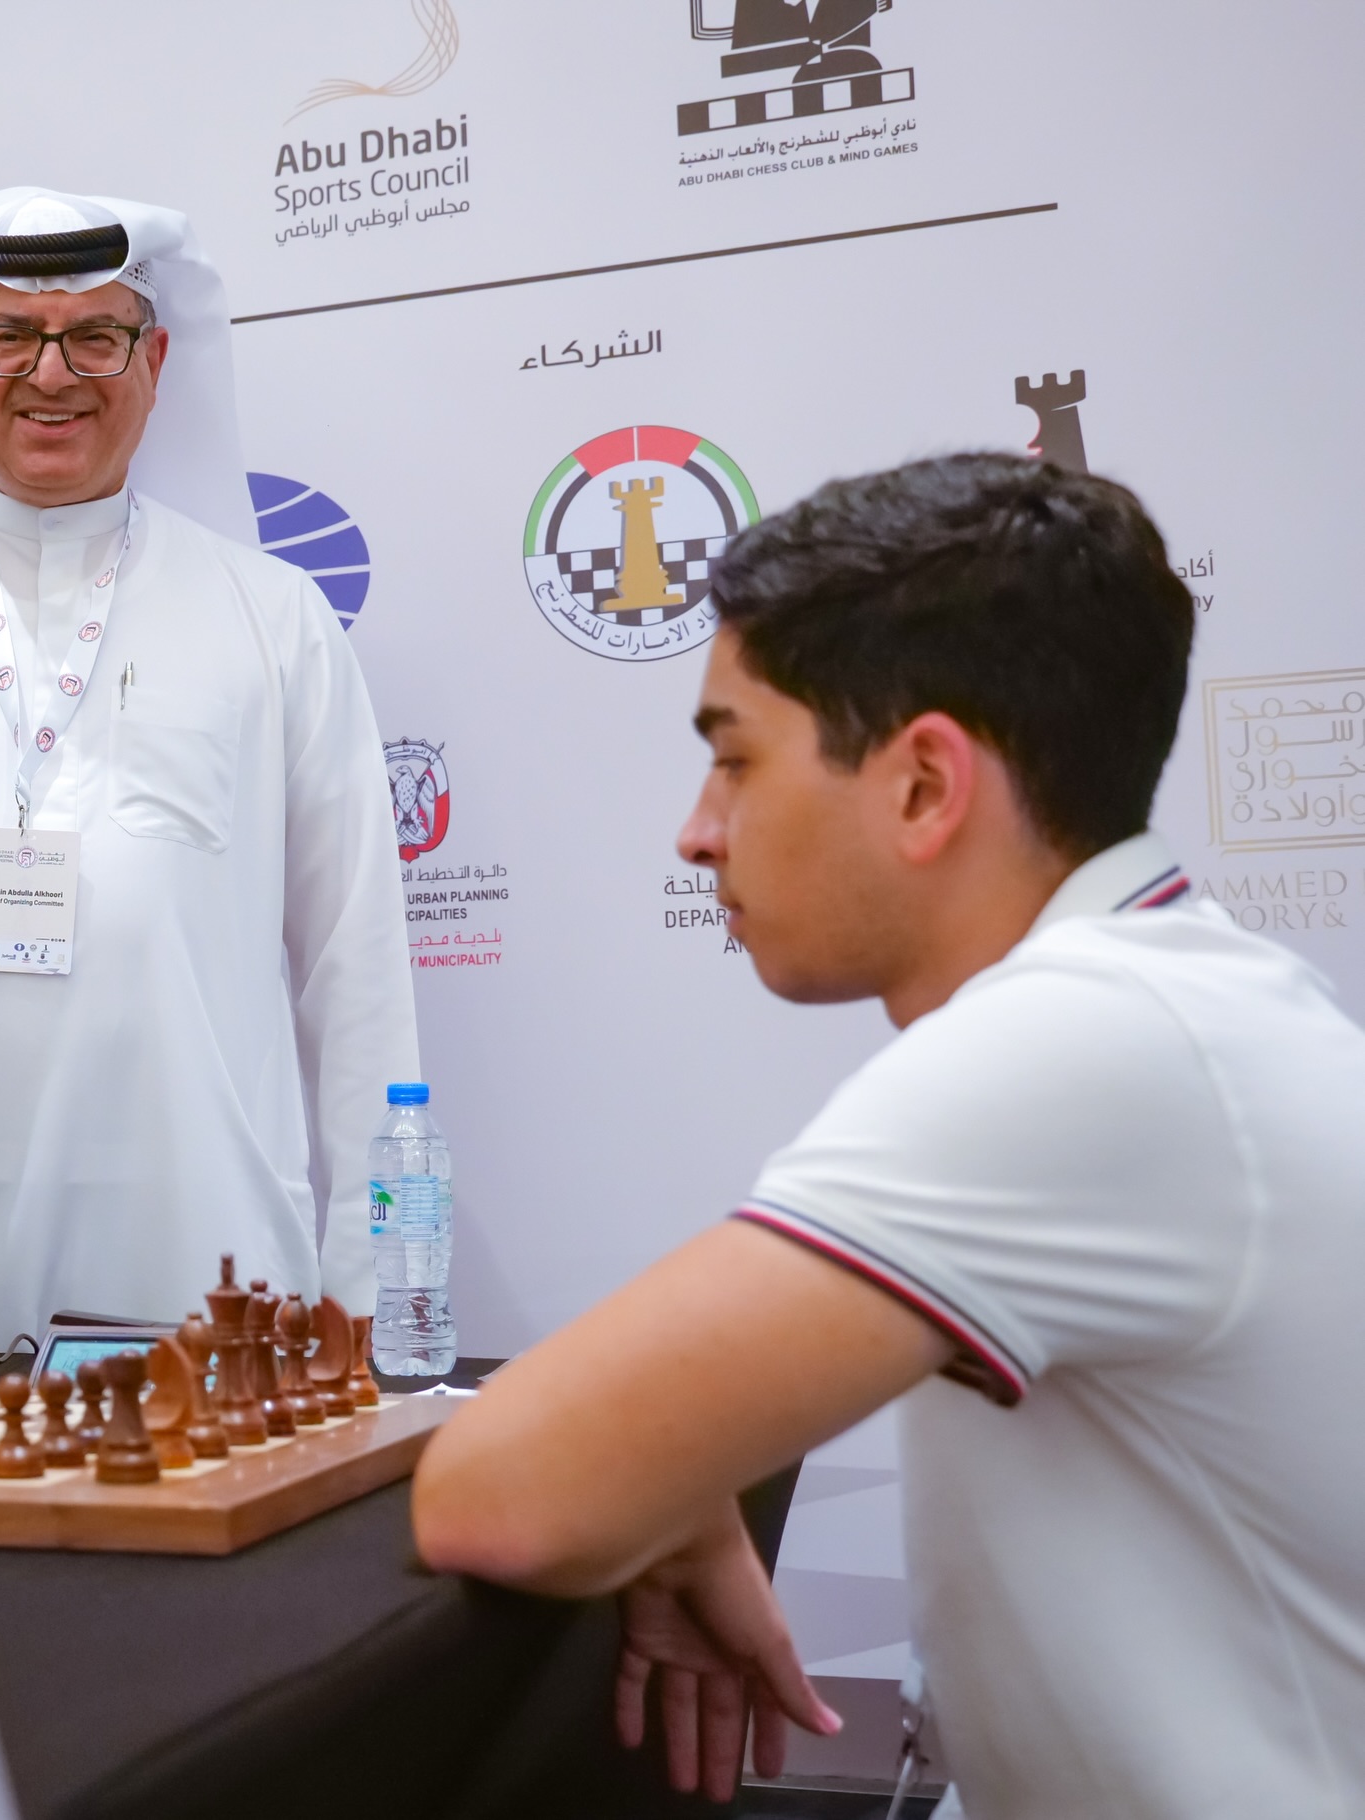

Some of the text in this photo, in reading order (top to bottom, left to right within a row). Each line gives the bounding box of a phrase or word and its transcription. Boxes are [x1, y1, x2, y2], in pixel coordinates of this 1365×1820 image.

[891, 119, 917, 141] نادي
[274, 114, 468, 177] Abu Dhabi
[678, 142, 919, 187] ABU DHABI CHESS CLUB & MIND GAMES
[274, 156, 469, 216] Sports Council
[275, 198, 470, 247] مجلس أبوظبي الرياضي
[518, 329, 662, 371] الشركاء
[474, 864, 507, 883] دائرة
[407, 888, 509, 905] URBAN PLANNING
[1198, 869, 1348, 902] AMMED
[3, 898, 33, 907] Organizing
[405, 908, 468, 922] ICIPALITIES
[665, 908, 727, 928] DEPAR
[418, 952, 502, 968] MUNICIPALITY
